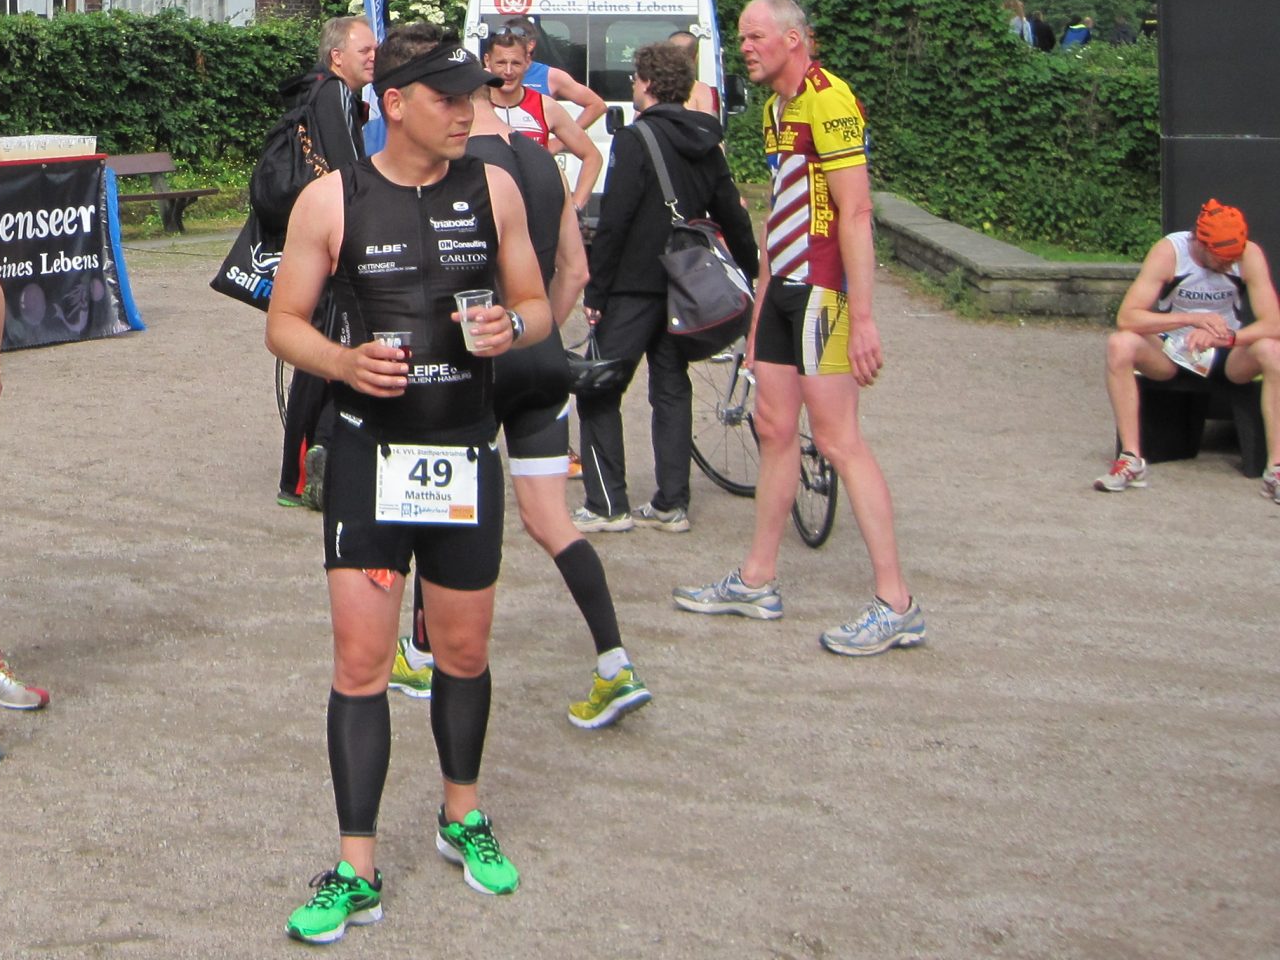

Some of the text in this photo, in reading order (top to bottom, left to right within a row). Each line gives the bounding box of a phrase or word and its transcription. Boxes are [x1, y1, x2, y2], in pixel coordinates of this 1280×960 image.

[540, 0, 684, 12] Quelle deines Lebens
[822, 116, 859, 134] power
[815, 163, 834, 238] owerBar
[365, 243, 403, 255] ELBE
[39, 250, 100, 275] Lebens
[440, 253, 488, 263] CARLTON
[407, 363, 450, 377] EIPE
[408, 458, 453, 488] 49
[404, 489, 452, 501] Matthäus
